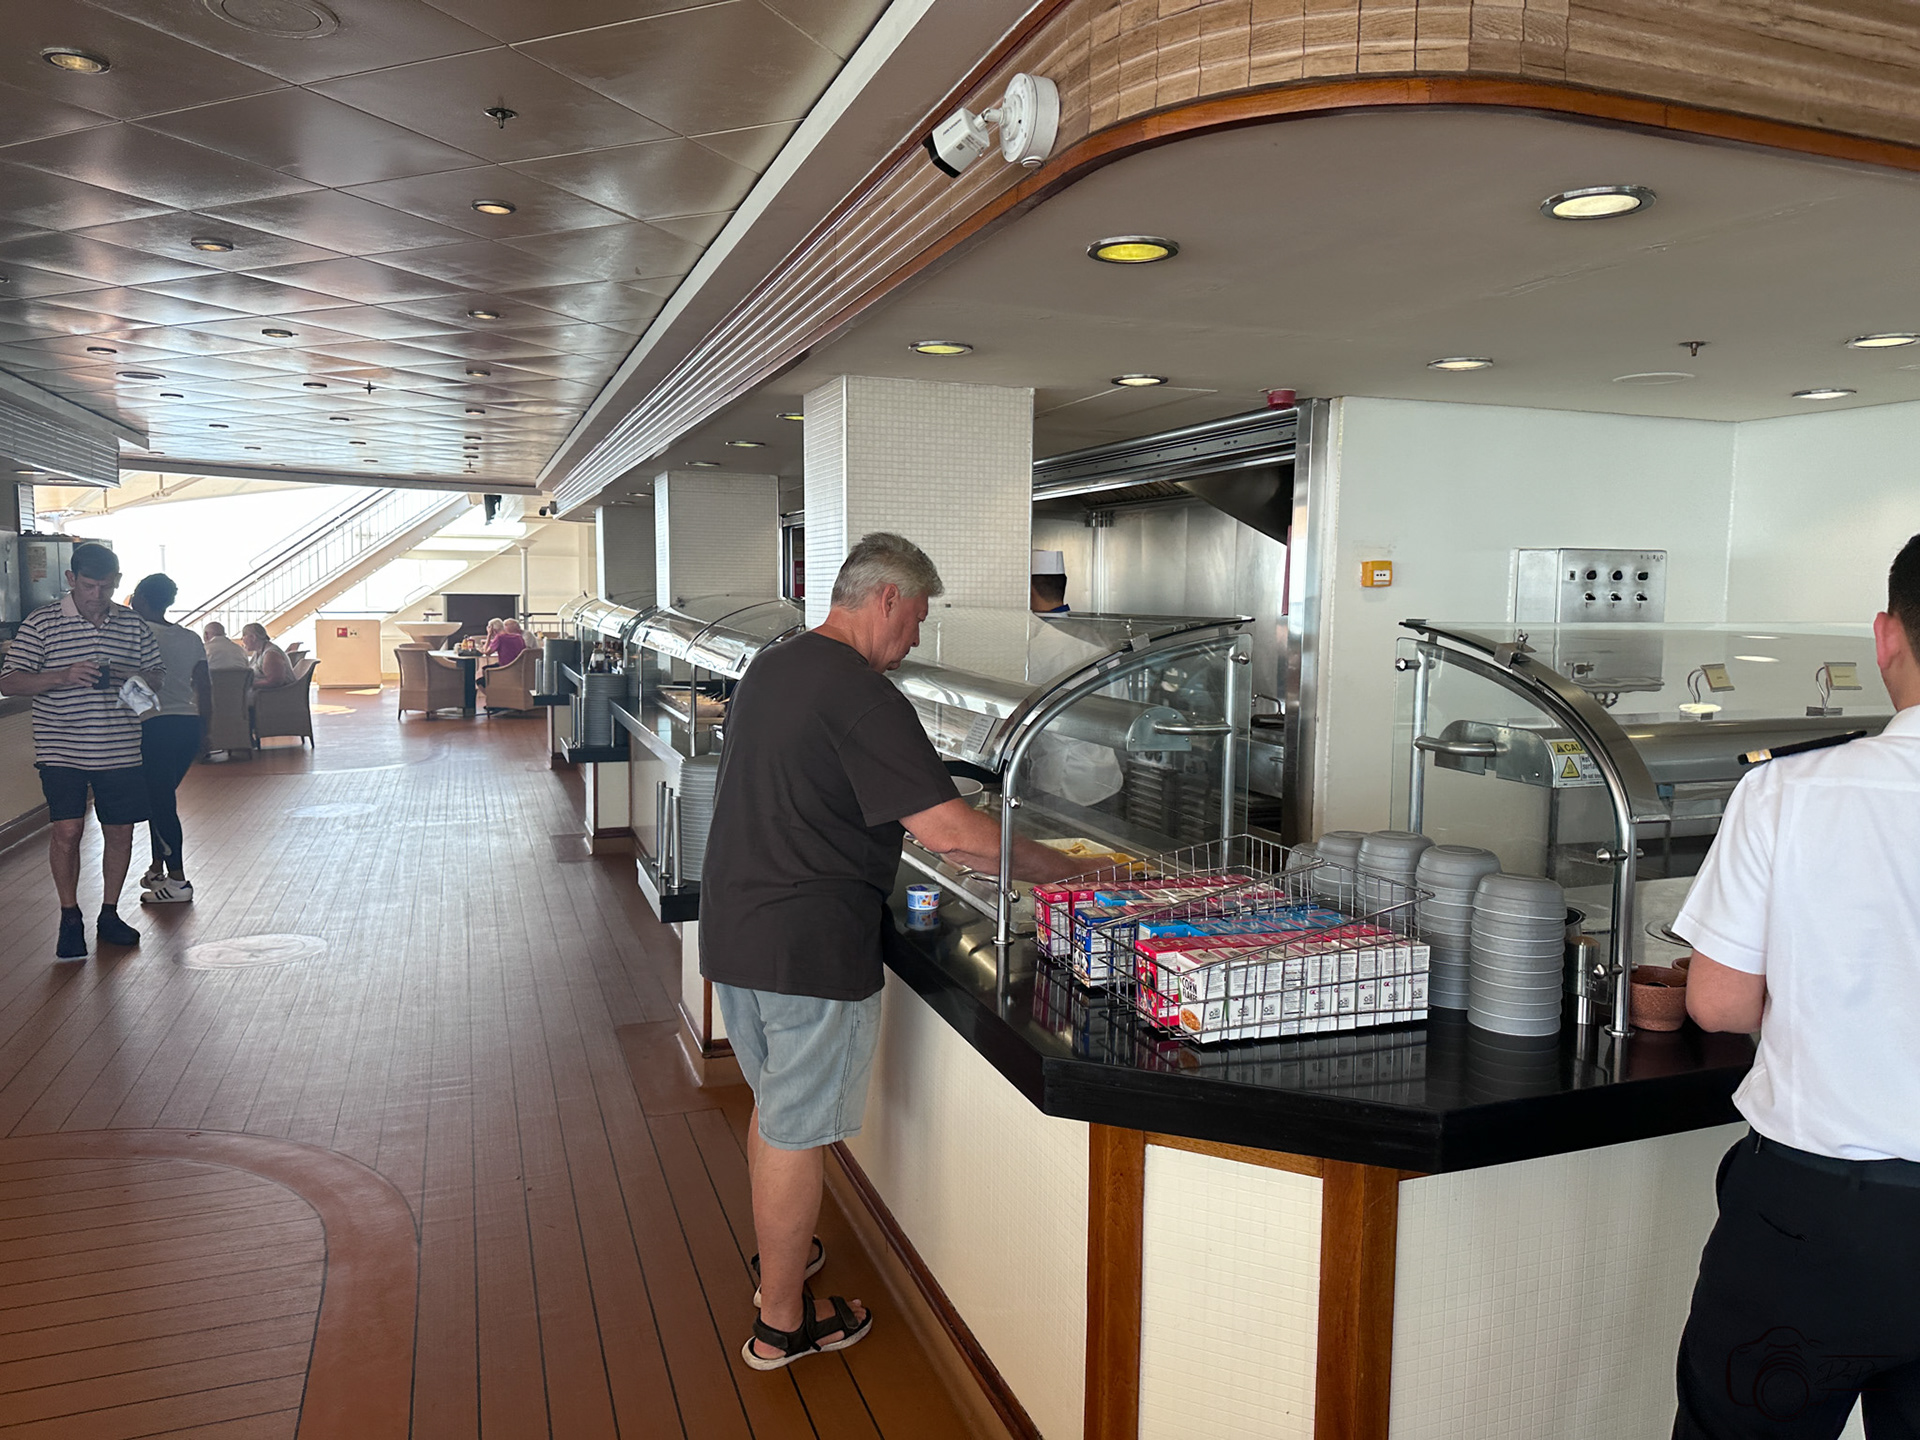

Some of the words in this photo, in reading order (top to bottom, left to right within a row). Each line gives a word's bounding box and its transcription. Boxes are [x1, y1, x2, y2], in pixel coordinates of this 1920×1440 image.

[1564, 743, 1583, 752] CAU
[1182, 977, 1197, 996] CORN
[1182, 988, 1199, 1003] FLAKES
